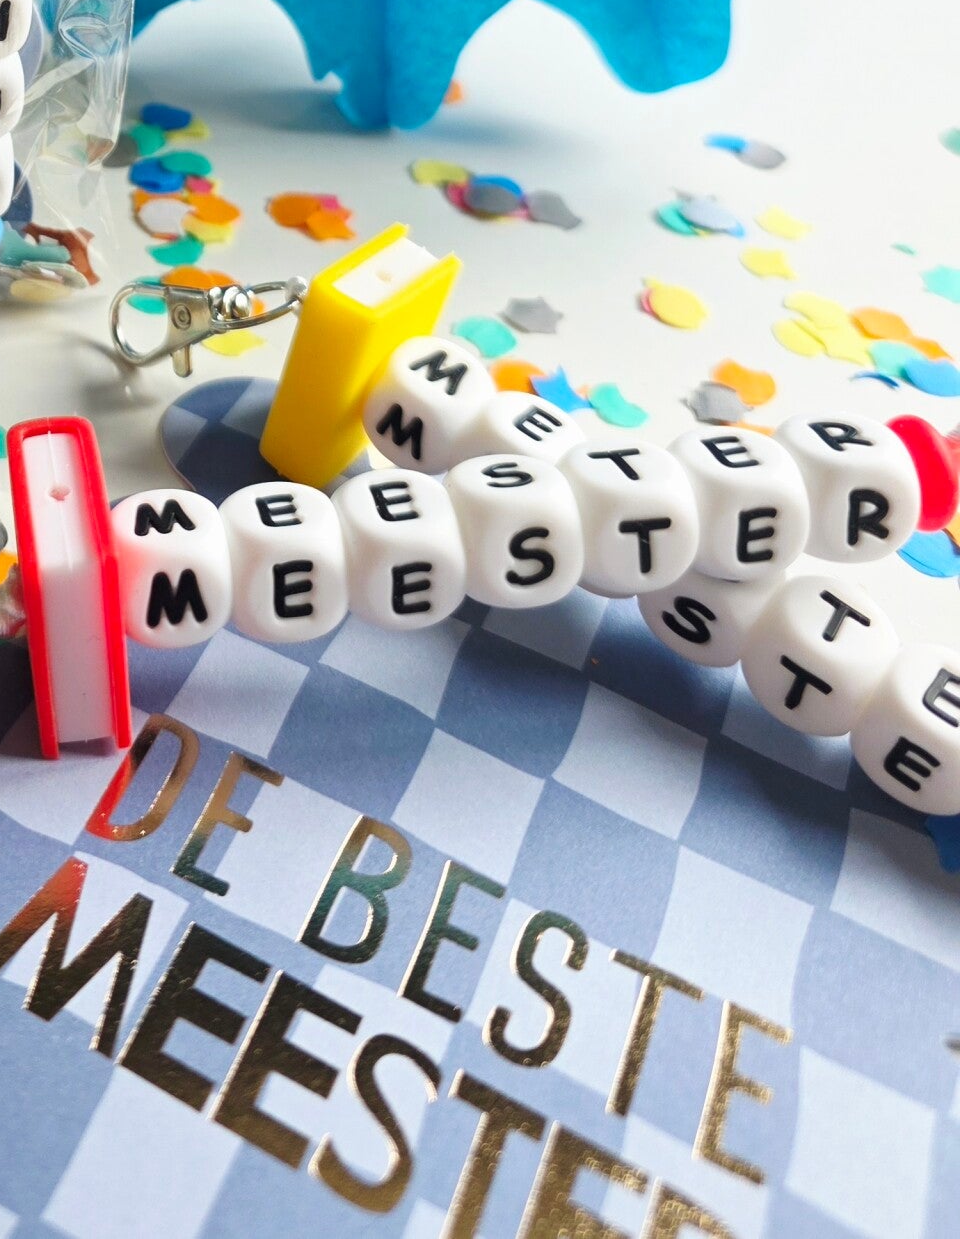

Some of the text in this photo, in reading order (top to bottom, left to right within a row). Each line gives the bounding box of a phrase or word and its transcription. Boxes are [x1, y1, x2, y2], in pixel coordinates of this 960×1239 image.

[135, 422, 872, 536] MEESTER
[147, 489, 888, 628] MEESTER
[85, 713, 793, 1185] DE BESTE
